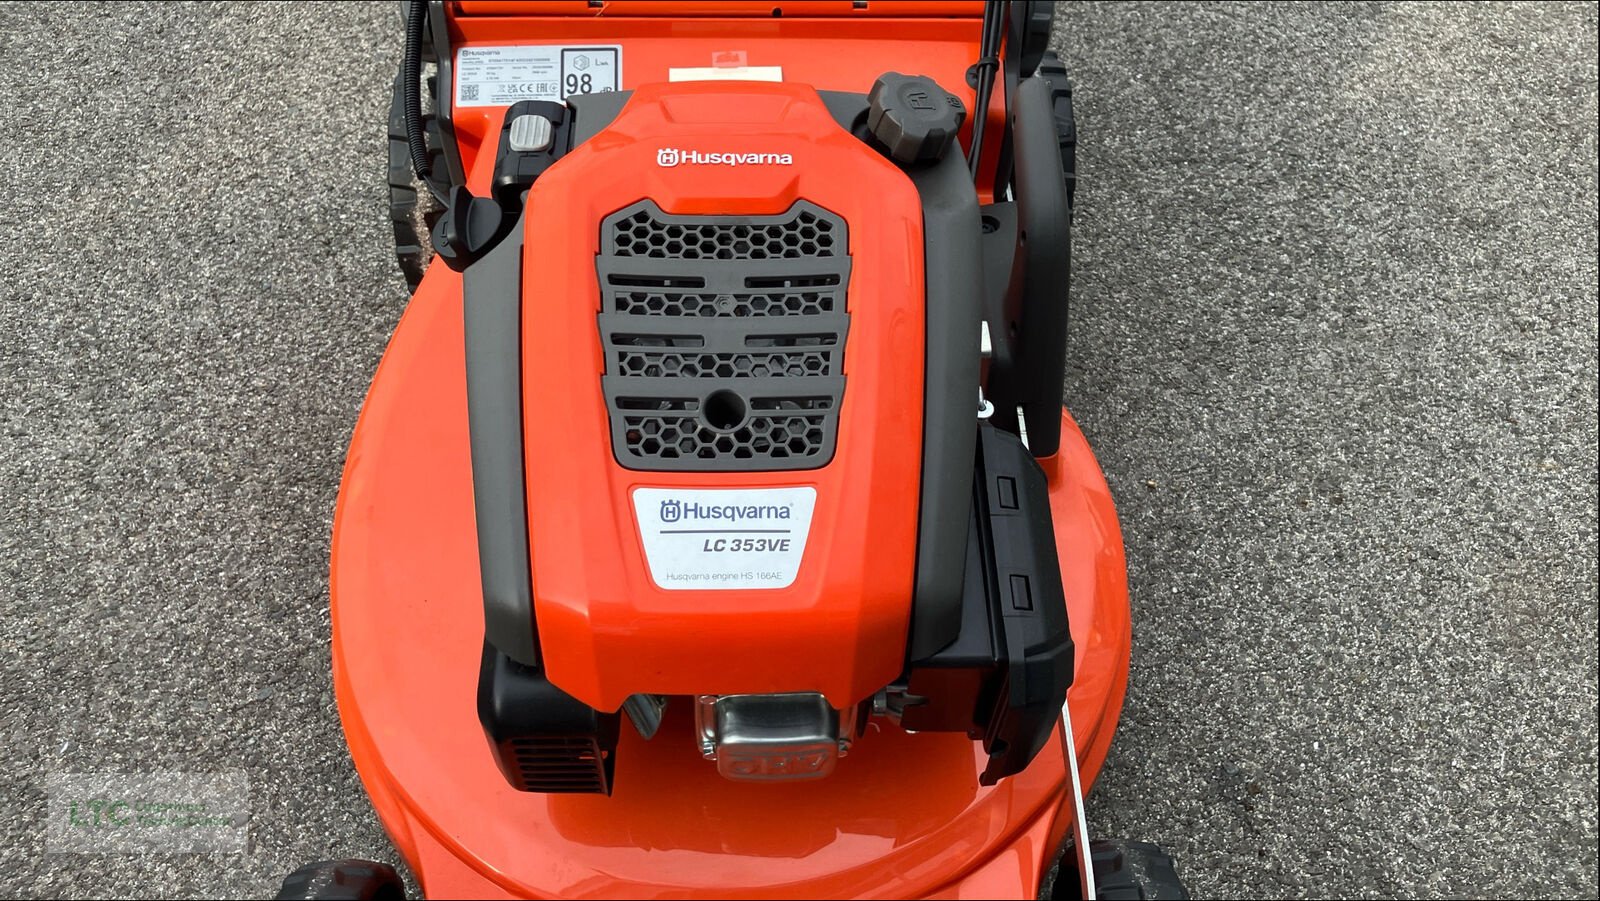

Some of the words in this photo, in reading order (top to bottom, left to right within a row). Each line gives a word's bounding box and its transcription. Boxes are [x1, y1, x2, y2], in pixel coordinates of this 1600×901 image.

[566, 73, 592, 94] 98
[681, 150, 793, 166] Husqvarna
[683, 502, 791, 521] Husqvarna
[703, 539, 726, 552] LC
[730, 539, 791, 552] 353VE
[666, 572, 710, 581] Husqvarna
[711, 573, 739, 581] engine
[741, 572, 754, 580] HS
[756, 572, 782, 580] 166AE
